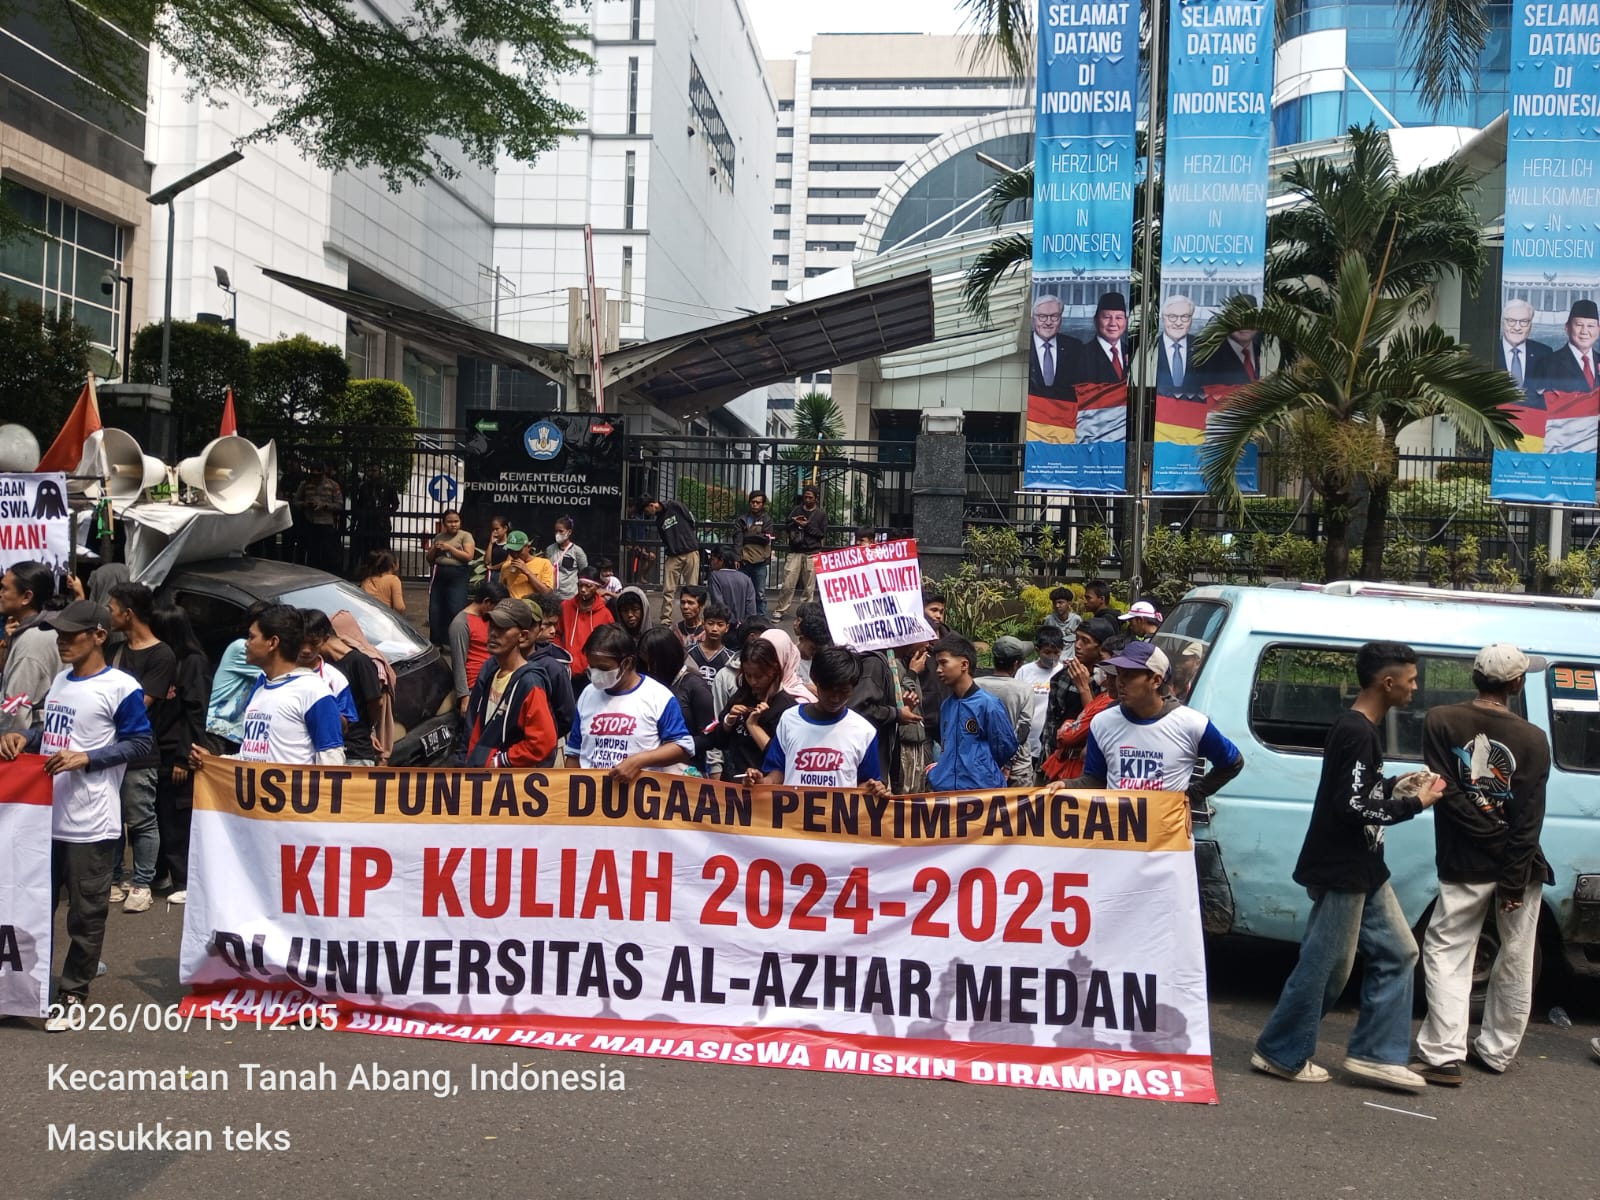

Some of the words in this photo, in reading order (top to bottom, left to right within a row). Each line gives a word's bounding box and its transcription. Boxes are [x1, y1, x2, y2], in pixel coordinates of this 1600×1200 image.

[1049, 4, 1130, 27] SELAMAT
[1181, 5, 1264, 27] SELAMAT
[1524, 3, 1600, 27] SELAMA
[1054, 31, 1122, 55] DATANG
[1187, 32, 1257, 55] DATANG
[1528, 33, 1600, 56] DATANG
[1078, 64, 1095, 86] DI
[1212, 64, 1229, 87] DI
[1554, 66, 1573, 89] DI
[1041, 90, 1132, 114] INDONESIA
[1173, 92, 1265, 115] INDONESIA
[1513, 94, 1600, 117] INDONESI
[1052, 153, 1118, 174] HERZLICH
[1184, 154, 1252, 174] HERZLICH
[1523, 158, 1593, 178] HERZLICH
[1037, 181, 1131, 202] WILLKOMMEN
[1168, 183, 1264, 203] WILLKOMMEN
[1076, 209, 1088, 227] IN
[1209, 209, 1222, 228] IN
[1548, 213, 1561, 232] IN
[1042, 233, 1121, 254] INDONESIEN
[1173, 234, 1253, 254] INDONESIEN
[1512, 239, 1594, 258] INDONESIEN
[500, 472, 587, 483] KEMENTERIAN
[494, 495, 518, 503] DAN
[522, 495, 591, 506] TEKNOLOGI
[821, 548, 864, 571] PERIKSA
[866, 547, 873, 561] &
[823, 572, 872, 604] KEPALA
[875, 565, 919, 594] LLDIKTI
[853, 595, 898, 621] WILAYAH
[45, 712, 68, 735] KIP
[244, 720, 266, 741] KIP
[593, 715, 634, 735] STOP!
[595, 738, 628, 751] KORUPSI
[1119, 750, 1163, 760] SELAMATKAN
[799, 751, 840, 770] STOP!
[1119, 758, 1158, 779] KIP
[800, 773, 836, 786] KORUPSI
[234, 766, 352, 815] USUT
[368, 771, 549, 817] TUNTAS
[568, 773, 752, 827] DUGAAN
[771, 790, 1148, 842] PENYIMPANGAN
[280, 844, 393, 918] KIP
[422, 848, 673, 922] KULIAH
[700, 854, 1091, 948] 2024-2025
[212, 930, 273, 976] DI
[286, 937, 644, 1001] UNIVERSITAS
[661, 945, 933, 1019] AL-AZHAR
[955, 964, 1157, 1033] MEDAN
[346, 1011, 501, 1043] BIARKAN
[506, 1029, 585, 1048] HAK
[589, 1036, 811, 1067] MAHASISWA
[823, 1049, 956, 1078] MISKIN
[970, 1060, 1185, 1098] DIRAMPAS!
